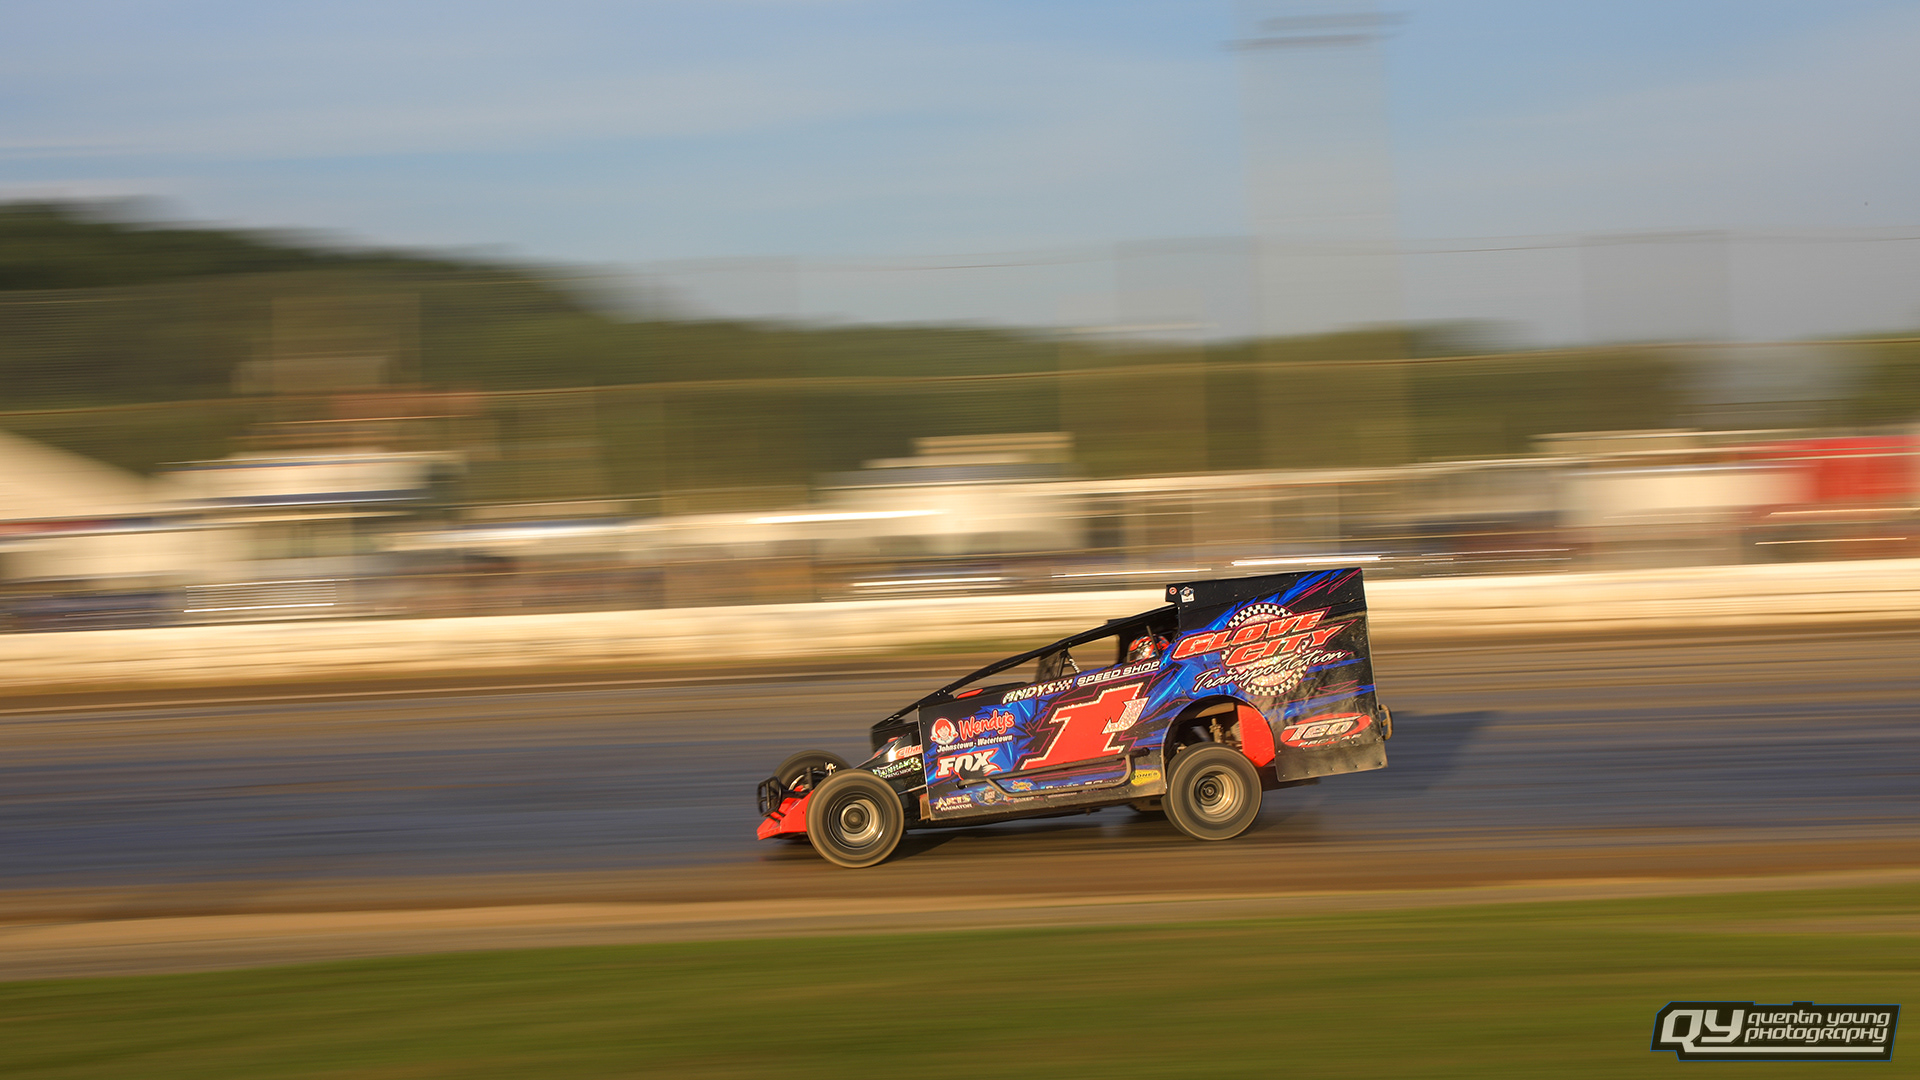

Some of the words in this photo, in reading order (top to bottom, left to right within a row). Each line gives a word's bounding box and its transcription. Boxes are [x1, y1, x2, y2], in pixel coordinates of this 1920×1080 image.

[1172, 610, 1326, 659] GLOVE
[1225, 624, 1346, 667] CITY
[1002, 682, 1057, 704] ANDYS
[1076, 669, 1121, 687] SPEED
[1122, 660, 1161, 678] SHOP
[1193, 650, 1346, 692] Transportation
[936, 741, 974, 753] Johnstown
[977, 734, 1013, 746] Watertown
[958, 709, 1014, 741] Wendy's
[936, 749, 996, 777] FOX
[940, 803, 973, 812] RADIATOR
